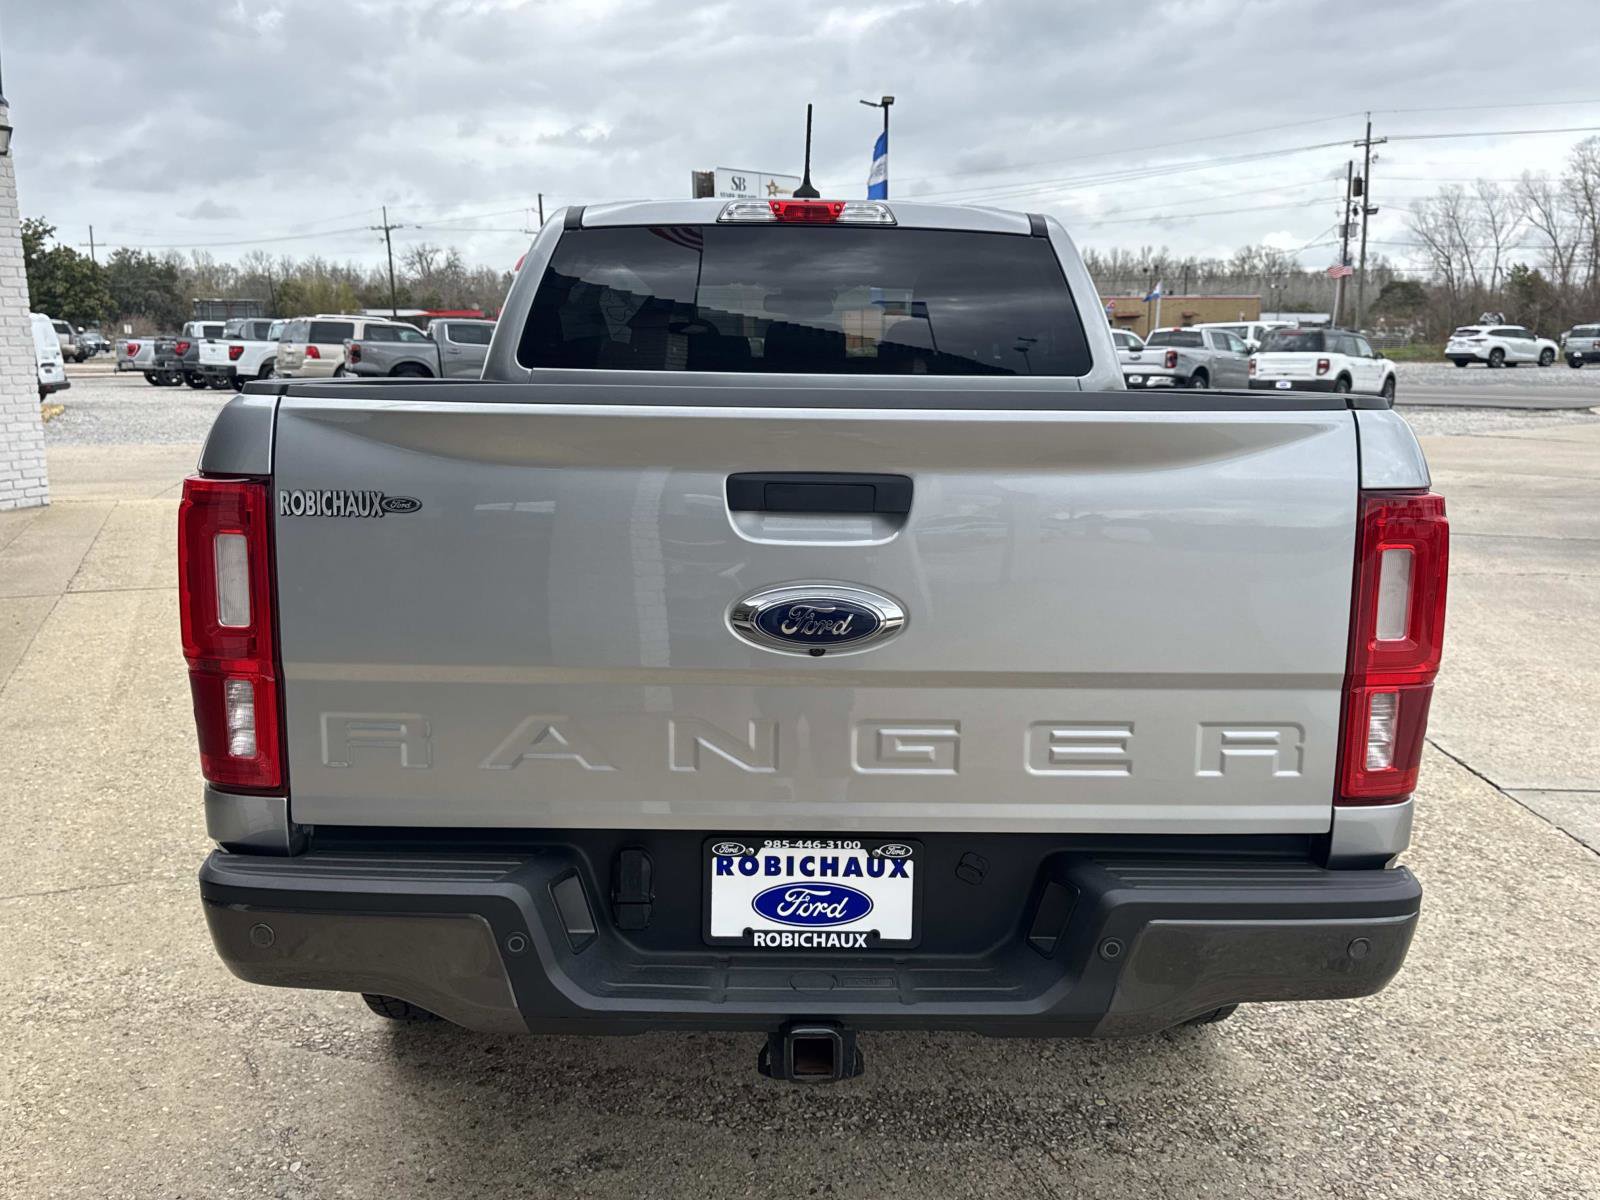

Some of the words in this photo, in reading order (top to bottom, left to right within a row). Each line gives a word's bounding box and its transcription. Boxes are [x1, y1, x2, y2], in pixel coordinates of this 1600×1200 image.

[731, 175, 747, 192] SB
[279, 490, 385, 518] ROBICHAUX
[781, 604, 854, 636] Ford
[319, 711, 1306, 778] RANGER
[718, 842, 739, 854] Ford
[763, 839, 862, 850] 985-446-3100
[885, 844, 907, 856] Ford
[716, 855, 910, 878] ROBICHAUX
[776, 887, 849, 919] Ford
[753, 932, 867, 948] ROBICHAUX
